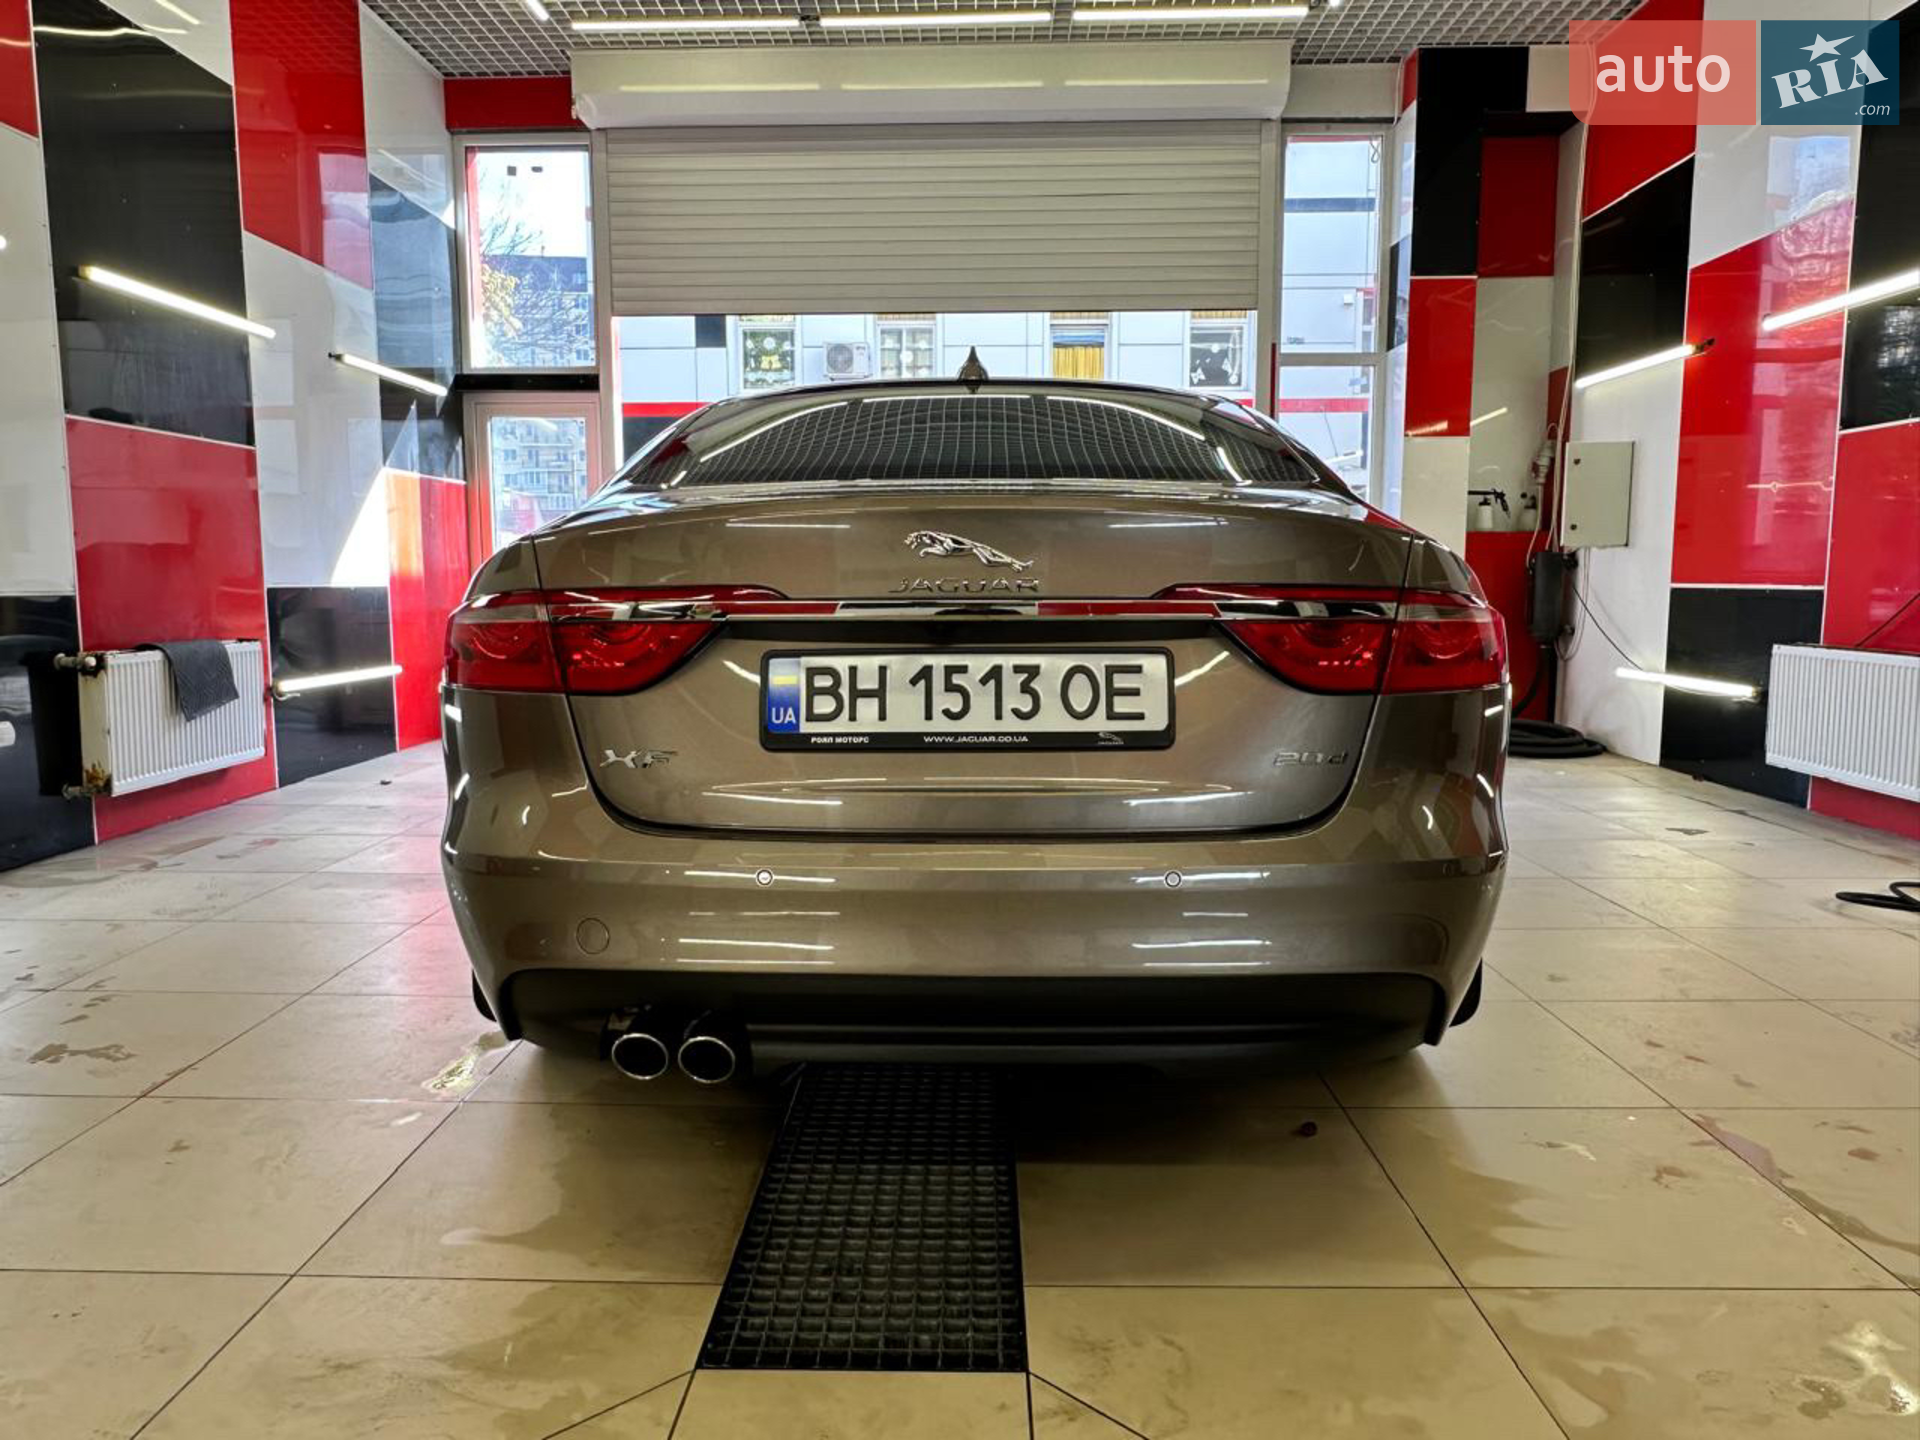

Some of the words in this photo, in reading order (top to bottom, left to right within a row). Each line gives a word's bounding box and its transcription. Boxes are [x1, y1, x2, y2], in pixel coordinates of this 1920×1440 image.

[888, 577, 1039, 593] JAGUAR
[805, 665, 888, 722] BH
[908, 664, 1041, 721] 1513
[1060, 664, 1146, 721] OE
[772, 706, 797, 724] UA
[923, 735, 1029, 744] WWW.JAGUAR.CO.UA
[600, 749, 678, 769] XF
